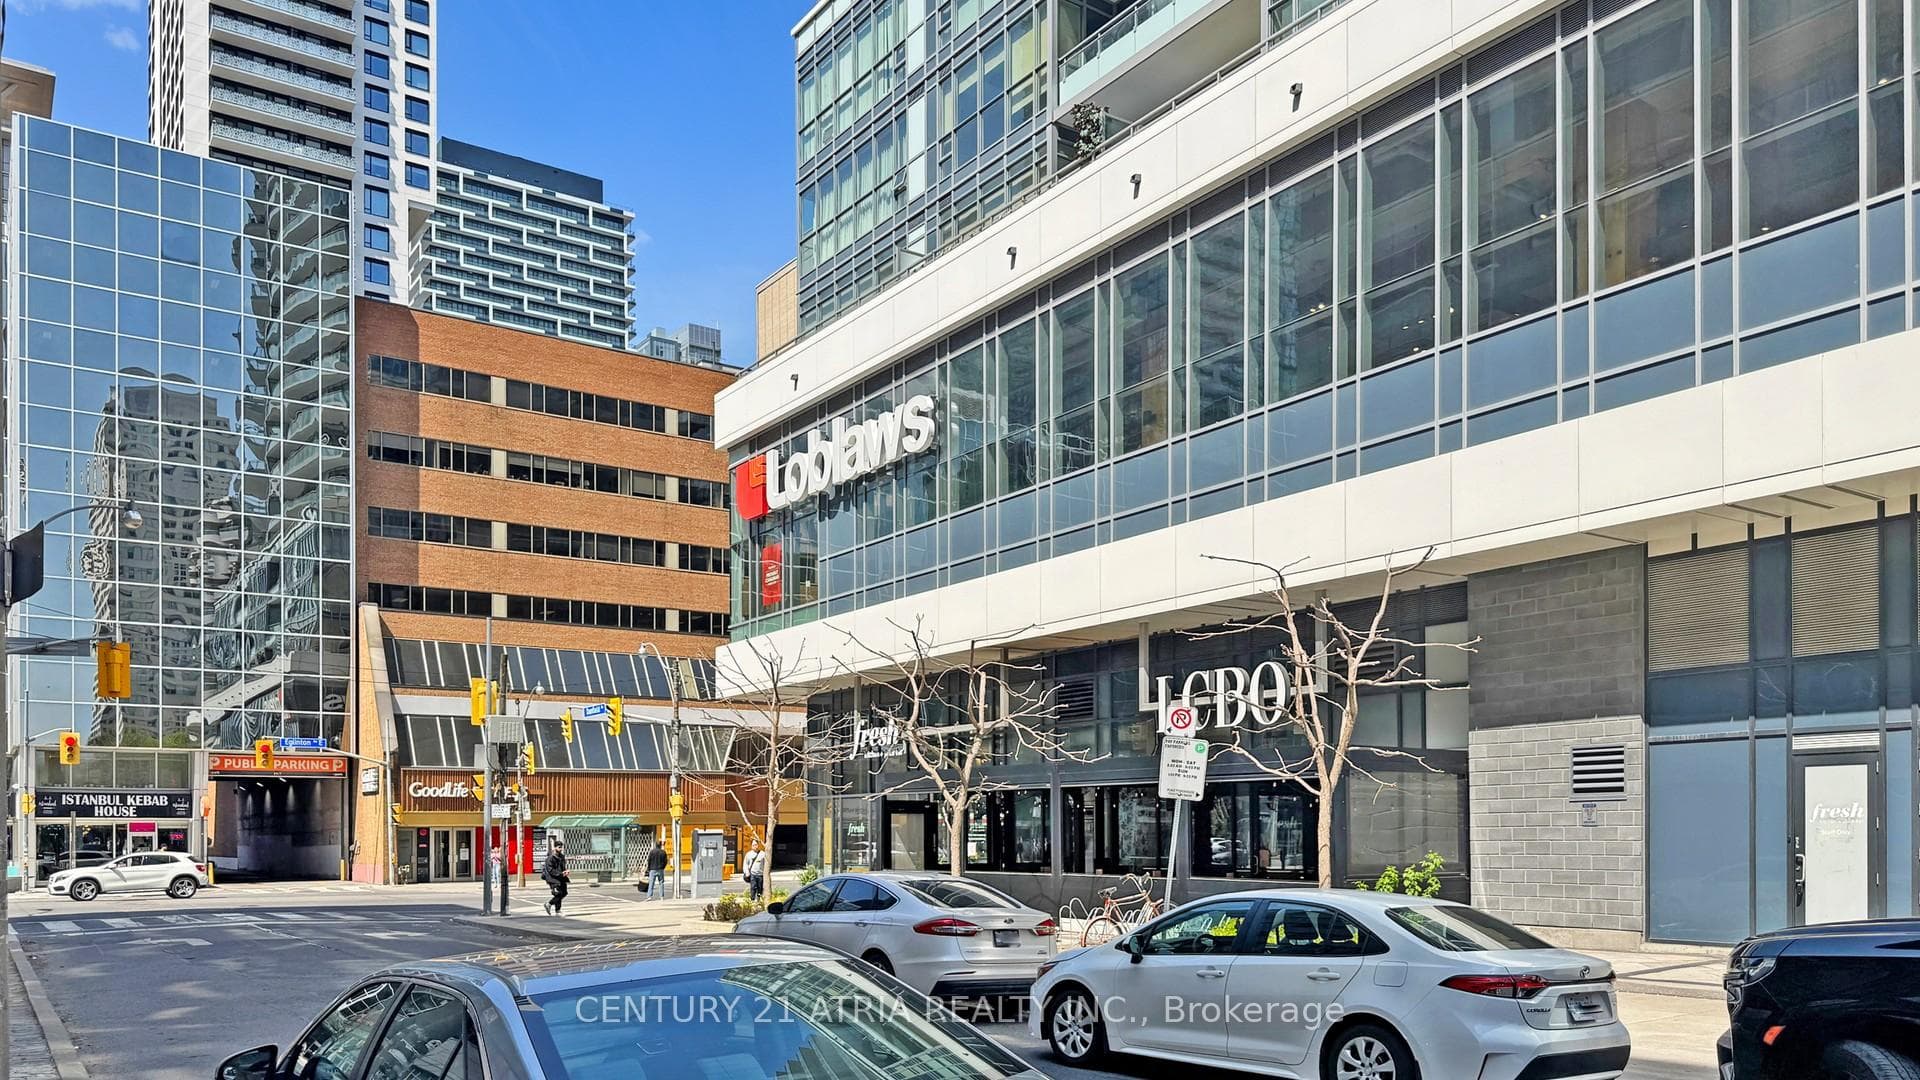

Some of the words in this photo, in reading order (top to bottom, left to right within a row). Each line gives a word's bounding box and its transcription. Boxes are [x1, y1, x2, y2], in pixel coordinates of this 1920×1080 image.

[765, 394, 936, 510] Loblaws
[1155, 661, 1293, 734] LCBO
[284, 738, 312, 748] Eglinton
[318, 739, 325, 747] E
[849, 719, 899, 761] fresh
[224, 758, 259, 769] PUBL
[273, 758, 330, 770] PARKING
[408, 781, 469, 798] GoodLife
[61, 794, 124, 806] ISTANBUL
[126, 794, 169, 806] KEBAB
[94, 806, 138, 817] HOUSE
[1808, 801, 1866, 823] fresh
